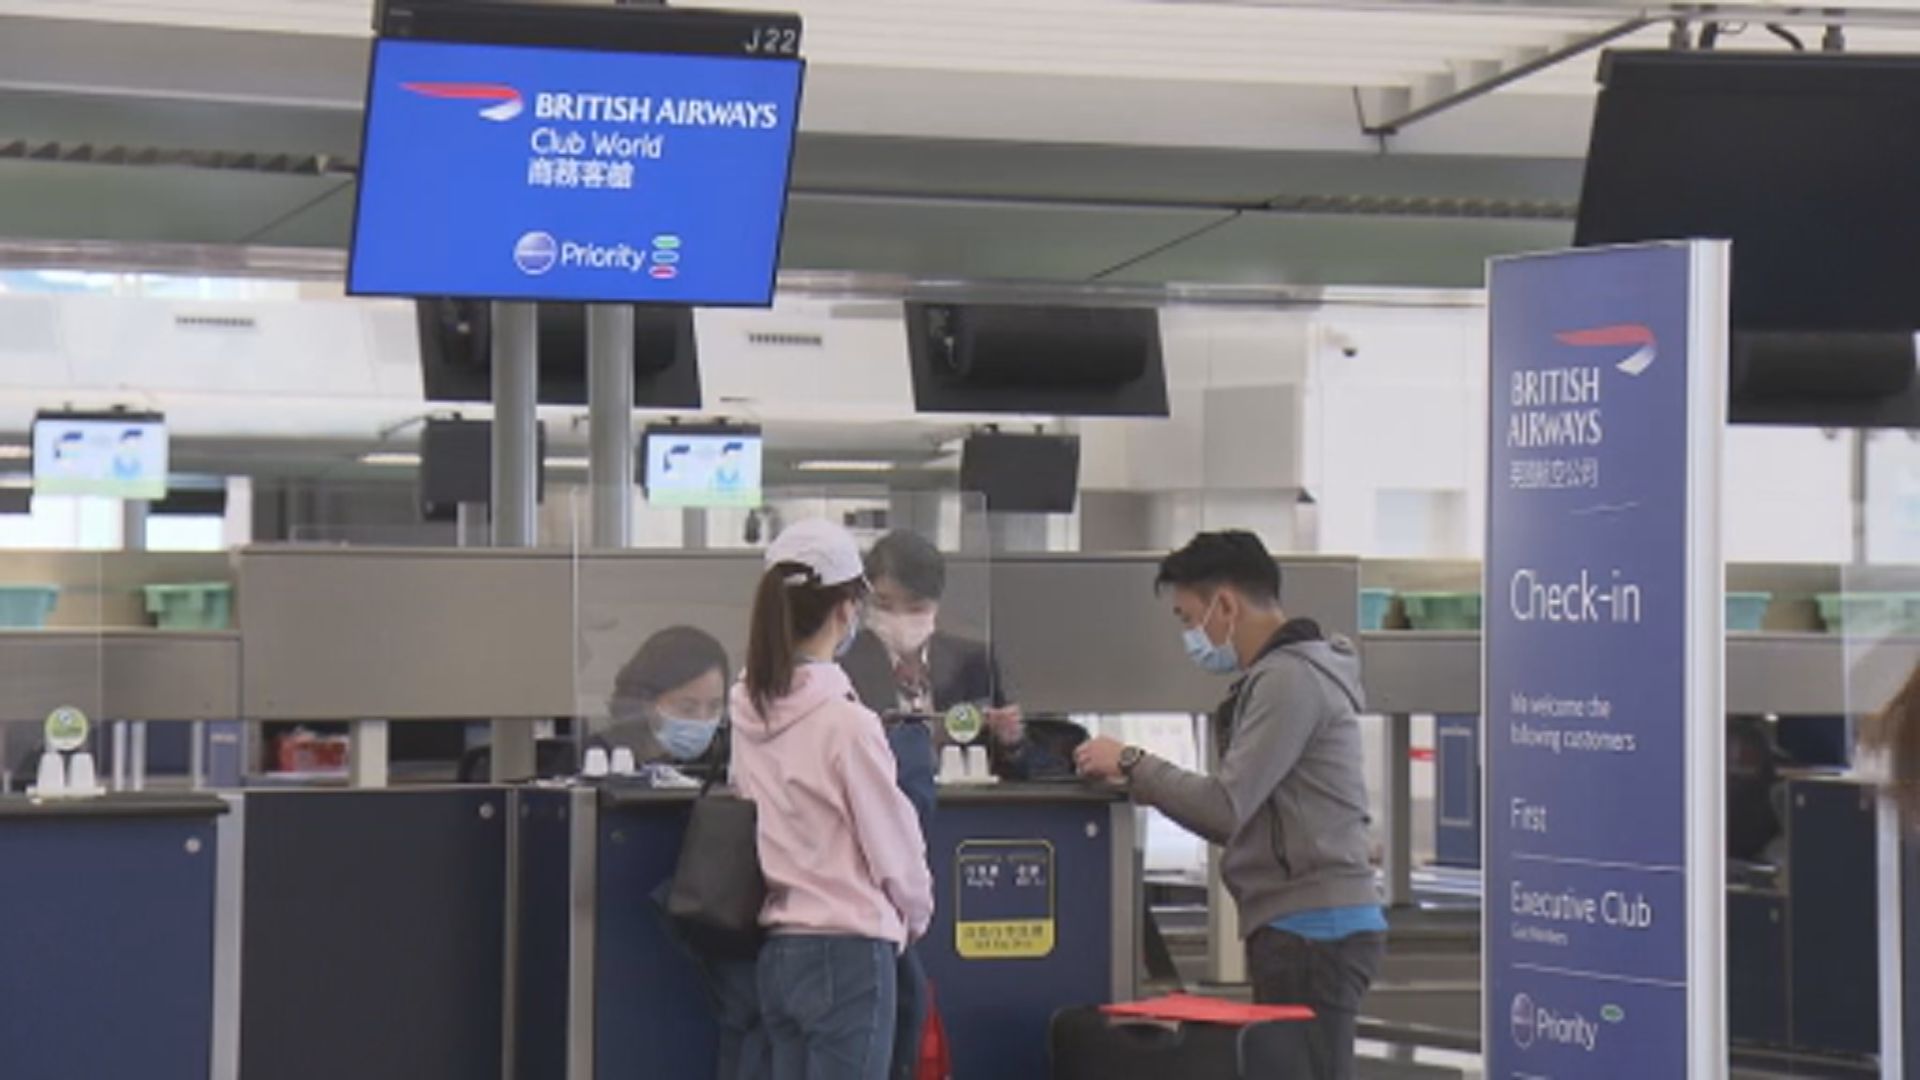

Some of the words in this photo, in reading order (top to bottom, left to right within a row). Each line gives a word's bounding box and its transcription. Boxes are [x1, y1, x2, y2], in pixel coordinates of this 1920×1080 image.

[535, 92, 651, 123] BRITISH
[656, 98, 778, 128] AIRWAYS
[531, 127, 585, 155] Club
[591, 131, 664, 158] World
[560, 242, 646, 272] Priority
[1511, 367, 1600, 405] BRITISH
[1507, 409, 1602, 447] AIRWAYS
[1510, 569, 1640, 622] Check-in
[1529, 694, 1584, 717] welcome
[1587, 693, 1611, 719] the
[1510, 722, 1561, 754] following
[1563, 730, 1636, 751] customers
[1511, 798, 1546, 832] First
[1511, 880, 1596, 924] Executive
[1601, 890, 1651, 928] Club
[1537, 1007, 1597, 1051] Priority
